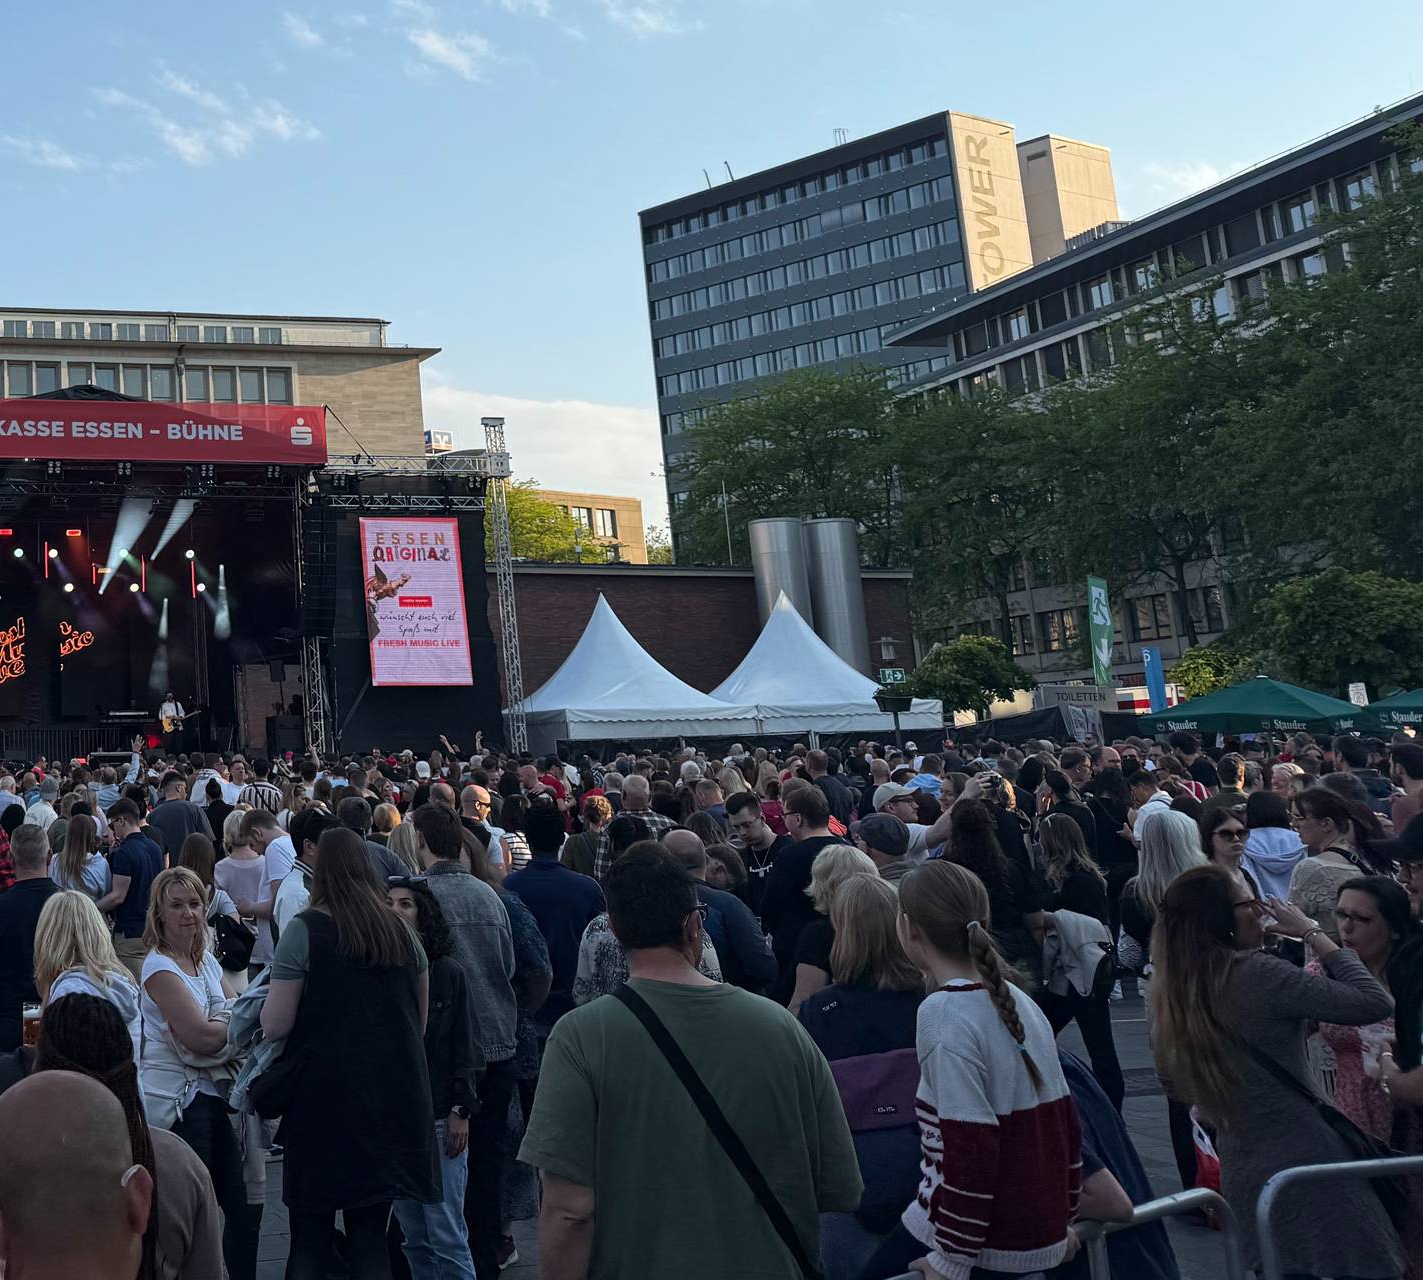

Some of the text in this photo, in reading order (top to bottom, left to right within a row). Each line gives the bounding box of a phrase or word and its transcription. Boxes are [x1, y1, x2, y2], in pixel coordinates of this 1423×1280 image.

[965, 135, 1005, 283] OWER
[71, 421, 143, 439] ESSEN
[167, 420, 244, 442] BÜHNE
[376, 532, 445, 545] ESSEN
[377, 639, 462, 648] FRESH MUSIC LIVE
[1056, 692, 1106, 702] TOILETTEN
[1391, 710, 1423, 724] Stauder
[1167, 719, 1198, 731] Stauder
[1273, 719, 1307, 731] Stauder
